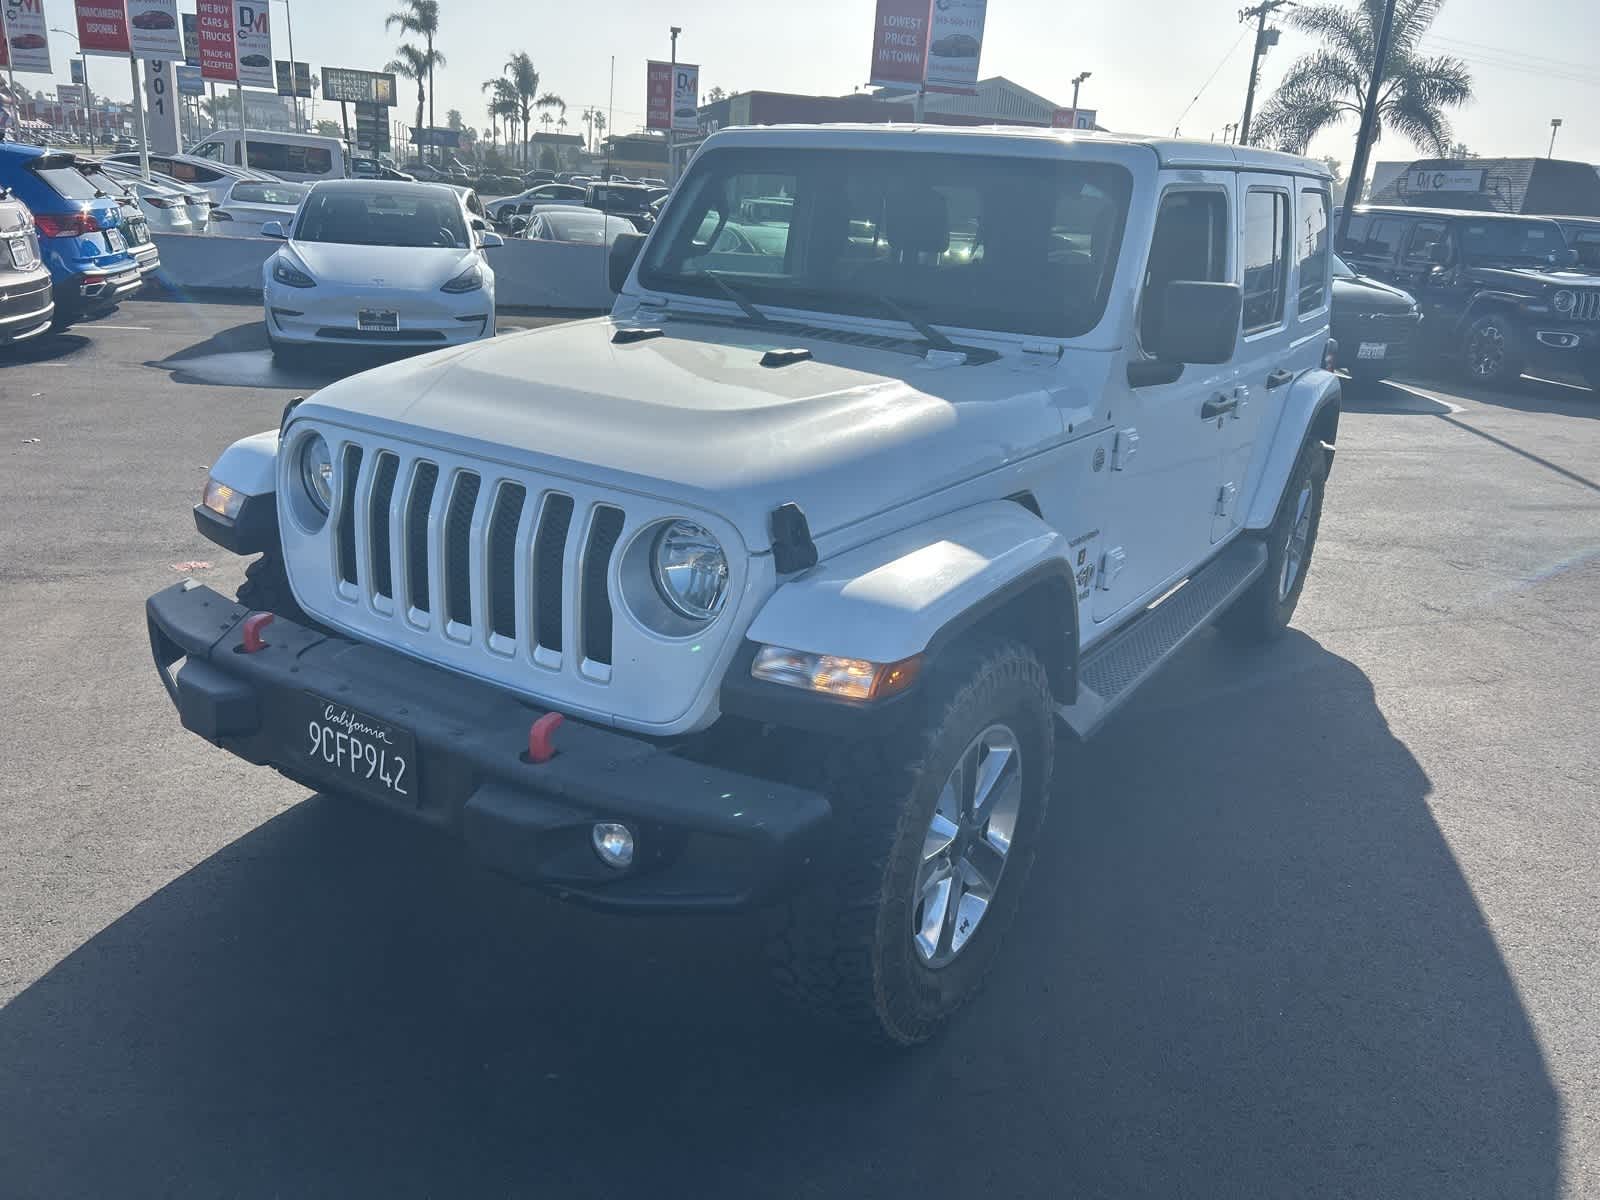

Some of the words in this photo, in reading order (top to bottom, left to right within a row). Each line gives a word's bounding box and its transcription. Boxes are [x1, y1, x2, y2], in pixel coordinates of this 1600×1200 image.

[200, 3, 212, 13] WE
[214, 4, 229, 14] BUY
[201, 17, 222, 28] CARS
[883, 15, 922, 29] LOWEST
[200, 30, 231, 41] TRUCKS
[884, 31, 917, 46] PRICES
[202, 49, 232, 59] TRADE-IN
[879, 48, 891, 61] IN
[892, 50, 921, 64] TOWN
[202, 60, 233, 70] ACCEPTED
[325, 704, 393, 744] California
[309, 721, 408, 794] 9CFP942
